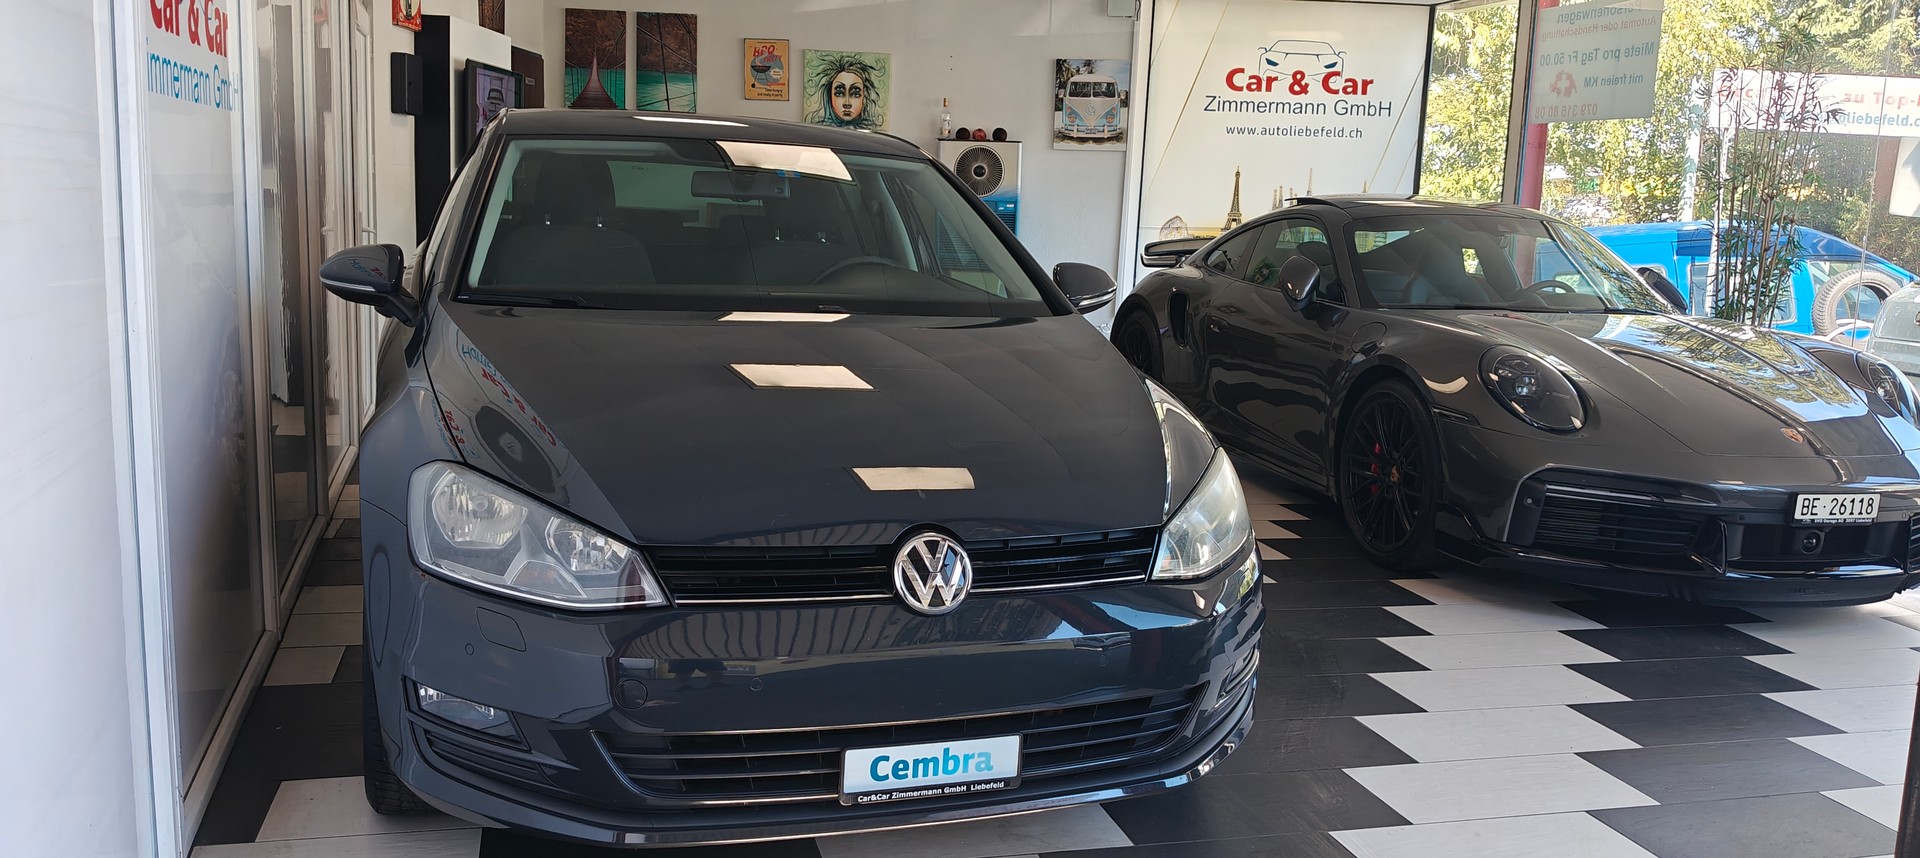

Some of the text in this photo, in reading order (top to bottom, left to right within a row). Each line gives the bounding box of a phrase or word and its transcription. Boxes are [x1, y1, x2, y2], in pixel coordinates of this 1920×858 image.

[204, 0, 228, 58] Car
[146, 36, 212, 106] immermann
[1225, 67, 1374, 96] Car & Car
[1203, 95, 1392, 117] Zimmermann GmbH
[1873, 91, 1920, 109] Top-
[1226, 125, 1363, 139] www.autoliebefeld.ch
[870, 747, 994, 782] Cembra
[857, 781, 1005, 803] Car&Car Zimmermann GmbH Liebefeld
